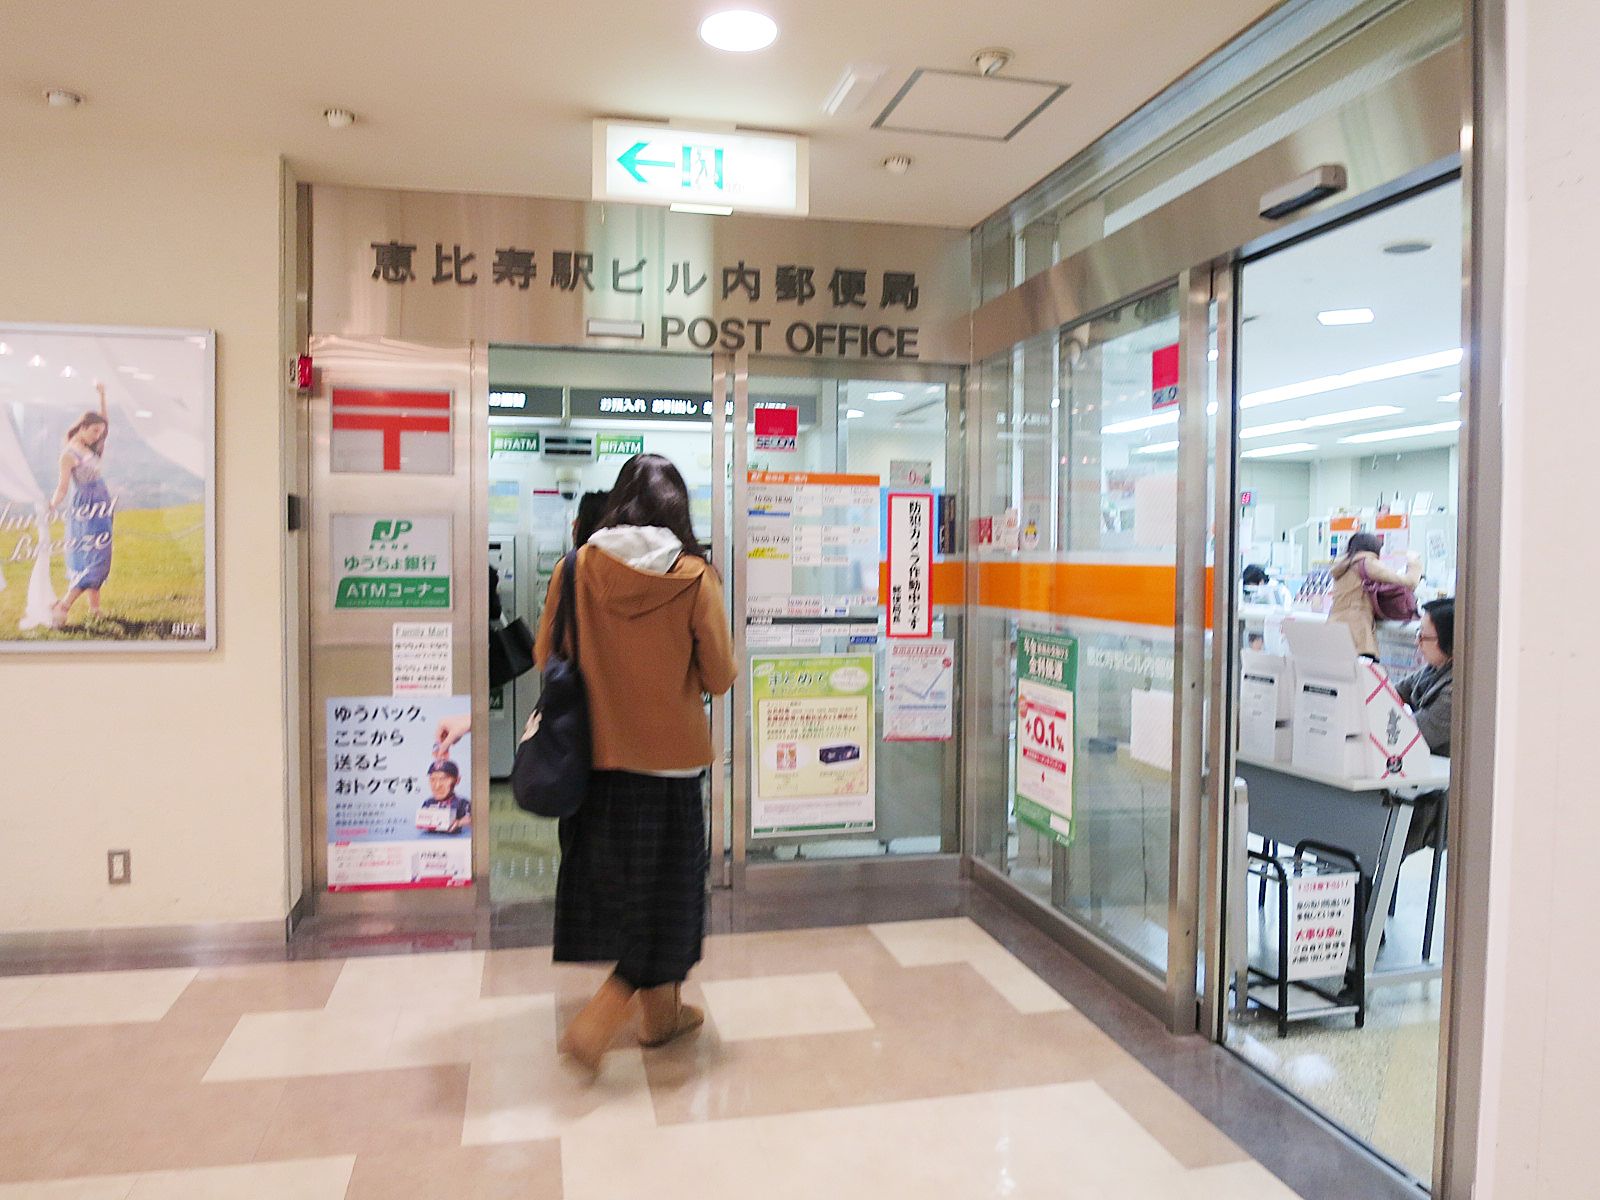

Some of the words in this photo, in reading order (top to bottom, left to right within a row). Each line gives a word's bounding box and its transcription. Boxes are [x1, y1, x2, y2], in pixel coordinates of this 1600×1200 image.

[370, 238, 919, 311] 恵比寿駅ビル内郵便局
[660, 315, 771, 353] POST
[785, 319, 920, 360] OFFICE
[756, 437, 796, 450] SECOM
[344, 554, 437, 572] ゆうちょ銀行
[908, 500, 922, 630] 防犯カメラ作動中です
[346, 582, 447, 599] ATMコーナー
[334, 704, 426, 723] ゆうパック。
[334, 729, 404, 747] ここから
[334, 753, 388, 772] 送ると
[334, 777, 421, 795] おトクです。
